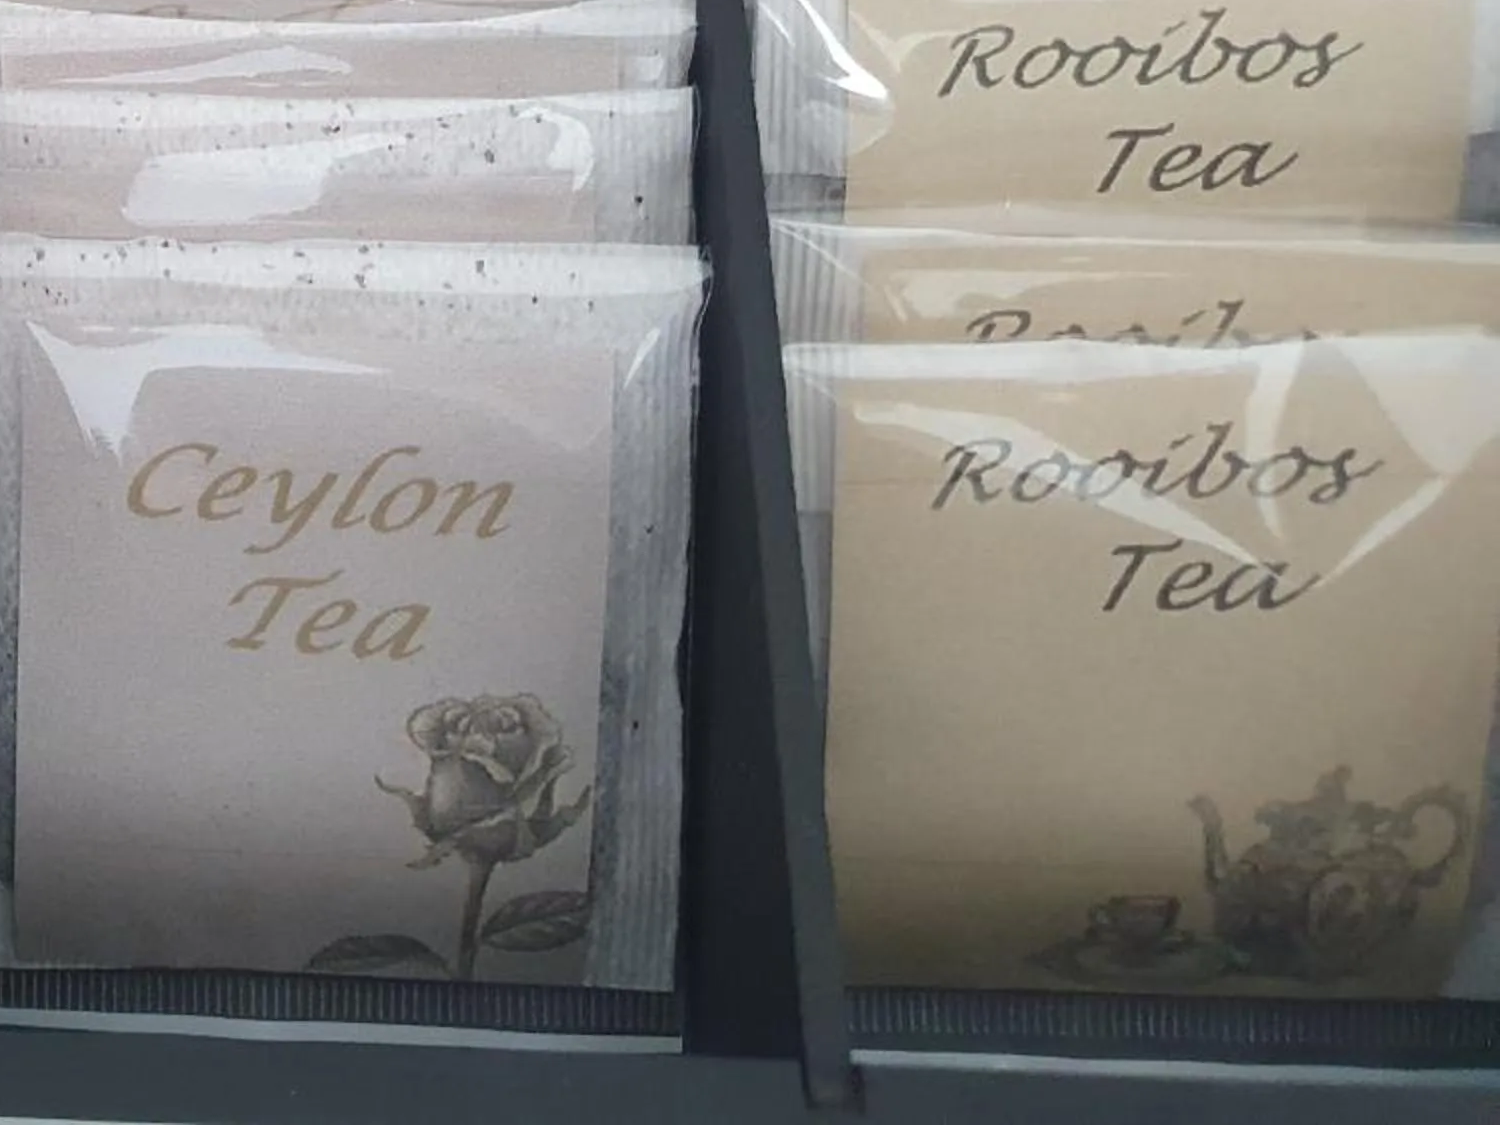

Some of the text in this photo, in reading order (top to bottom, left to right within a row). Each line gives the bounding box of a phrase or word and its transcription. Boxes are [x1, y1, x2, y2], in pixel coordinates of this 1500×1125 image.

[936, 7, 1365, 99] Rooibos
[1096, 122, 1299, 193] Tea
[122, 441, 519, 558] Ceylon
[931, 421, 1386, 510] Rooibos
[225, 568, 434, 665] Tea
[1102, 538, 1322, 612] Tea
